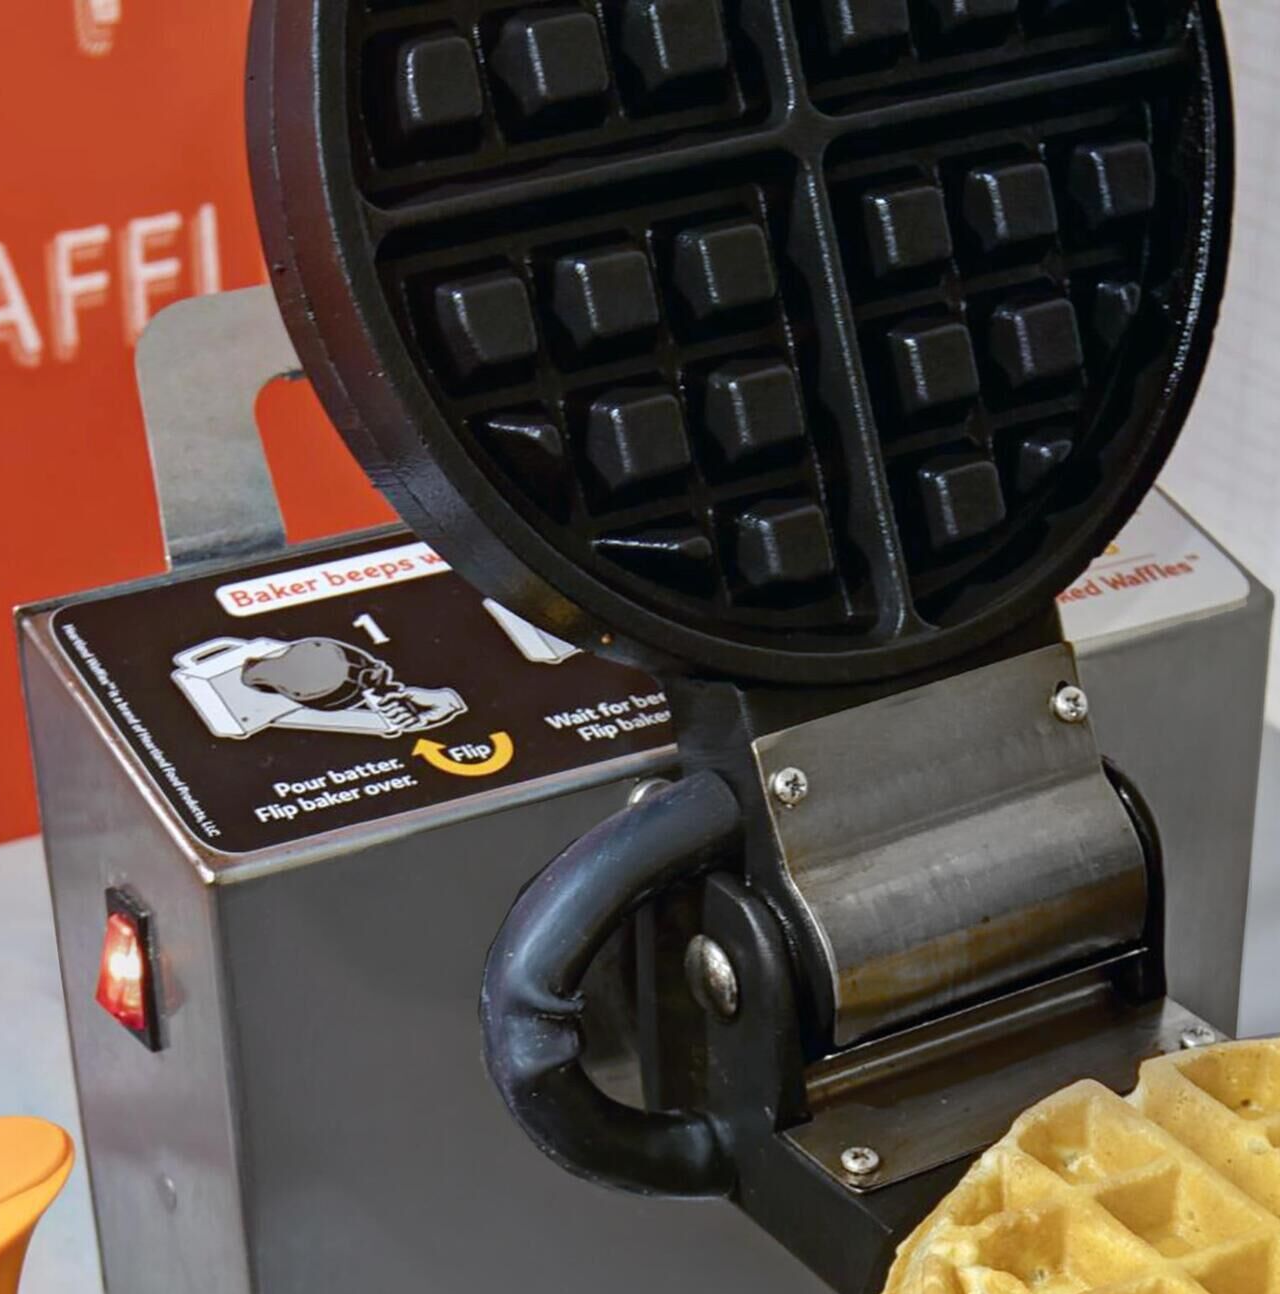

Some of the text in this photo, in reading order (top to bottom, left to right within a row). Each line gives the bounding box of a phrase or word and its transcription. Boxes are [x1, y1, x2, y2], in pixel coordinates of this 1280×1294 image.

[228, 577, 318, 609] Baker
[322, 555, 415, 588] beeps
[352, 612, 391, 645] 1
[544, 708, 600, 730] Wait
[597, 700, 630, 718] for
[576, 722, 619, 742] Flip
[447, 742, 492, 763] Flip
[273, 757, 405, 798] Pour batter.
[254, 772, 419, 823] Flip baker over.
